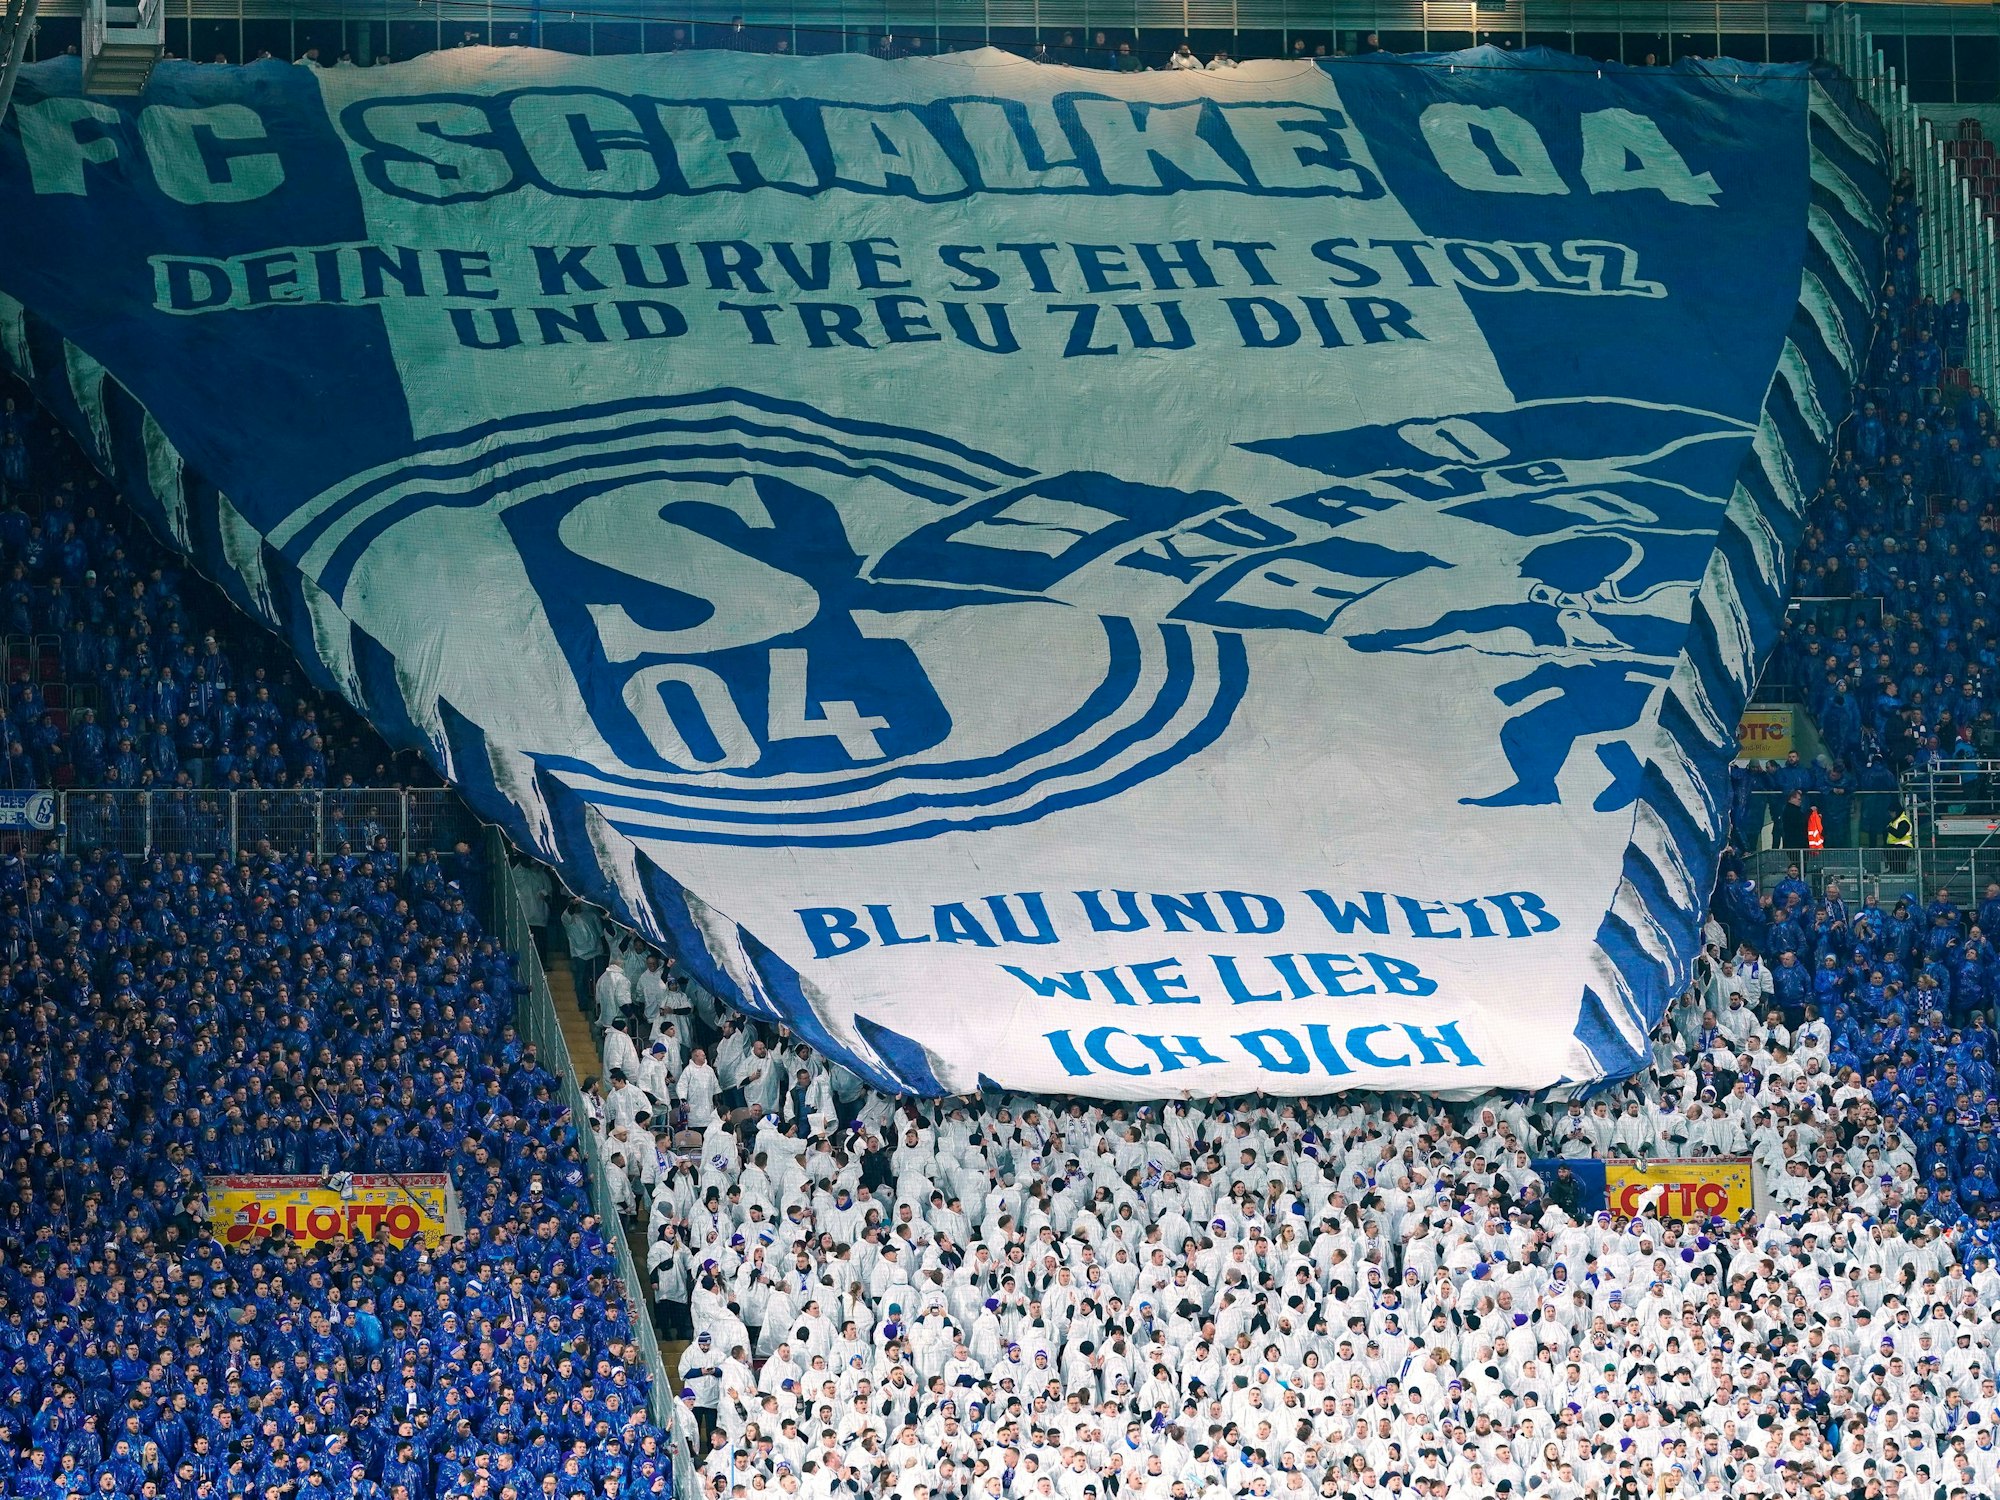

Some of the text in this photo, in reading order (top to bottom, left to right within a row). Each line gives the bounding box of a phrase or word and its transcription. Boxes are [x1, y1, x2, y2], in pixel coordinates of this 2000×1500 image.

[14, 86, 1723, 208] FC SCHALKE 04
[155, 237, 1660, 309] DEINE KURVE STEHT STOLZ
[445, 294, 1432, 358] UND TREU ZU DIR
[558, 476, 820, 664] S
[622, 648, 892, 773] 04
[795, 892, 1059, 959] BLAU
[1073, 888, 1285, 934] UND
[995, 951, 1438, 1006] WIE LIEB
[1042, 1020, 1486, 1077] ICH DICH
[286, 1206, 421, 1240] LOTTO
[1606, 1183, 1728, 1217] LOTTO
